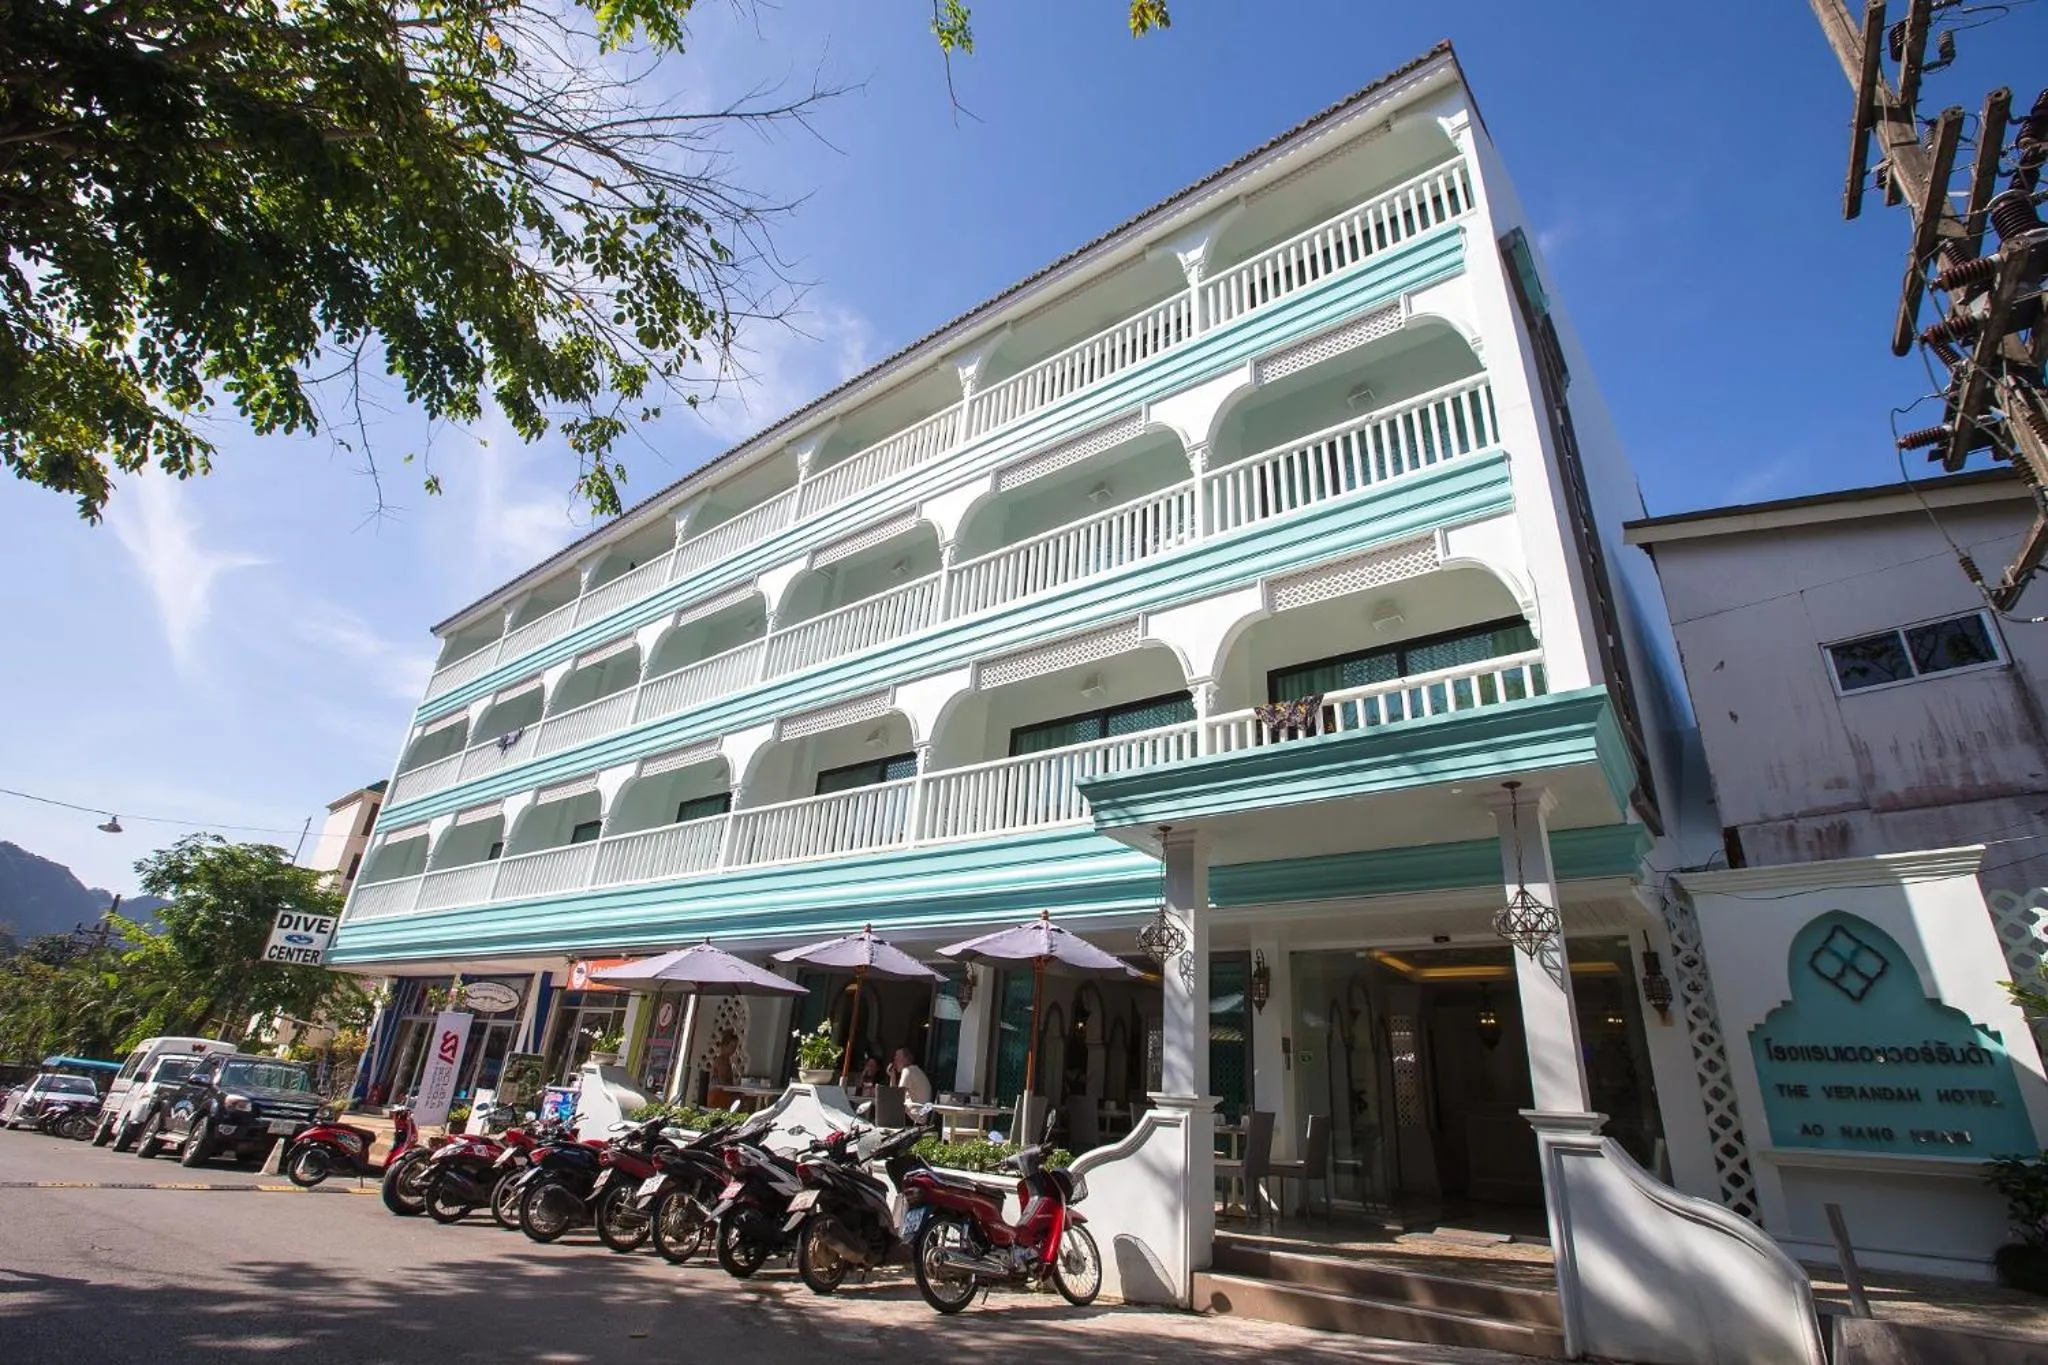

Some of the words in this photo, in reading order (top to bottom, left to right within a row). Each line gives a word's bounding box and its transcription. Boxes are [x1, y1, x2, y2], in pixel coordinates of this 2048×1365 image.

[277, 913, 331, 934] DIVE
[268, 945, 321, 963] CENTER
[1774, 1083, 1811, 1099] THE
[1821, 1085, 1922, 1102] VERANDAH
[1936, 1088, 2000, 1106] HOTEL
[1801, 1123, 1825, 1137] AO
[1840, 1125, 1895, 1142] NANG
